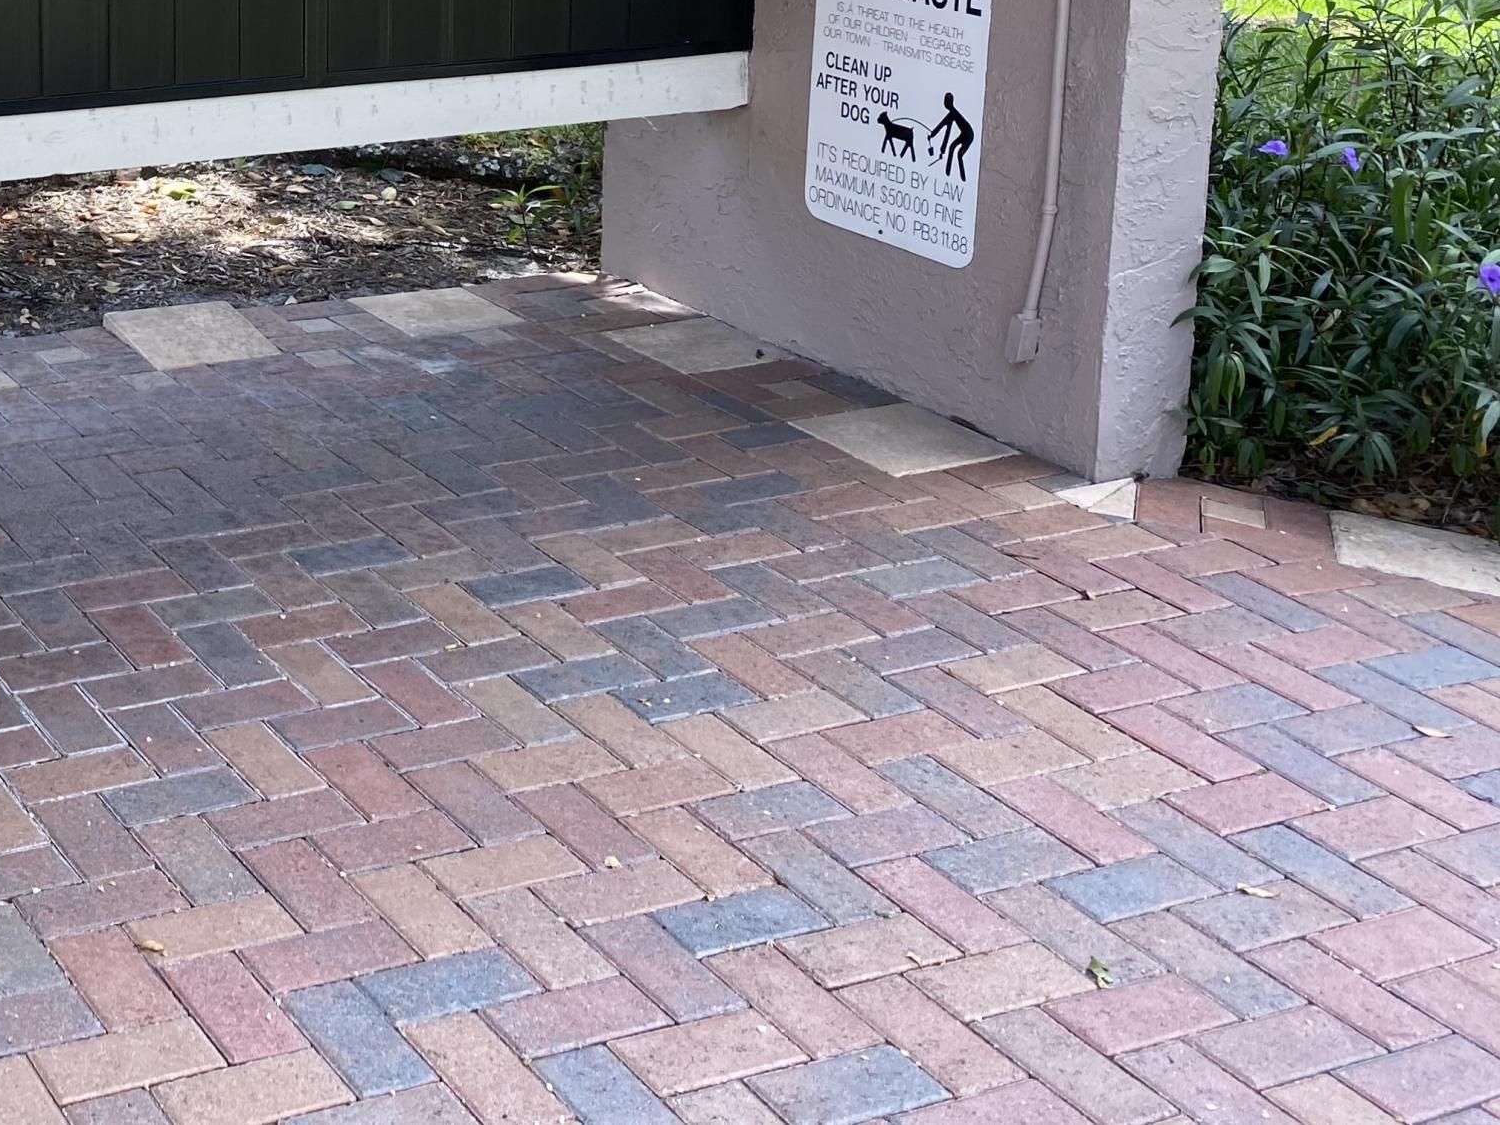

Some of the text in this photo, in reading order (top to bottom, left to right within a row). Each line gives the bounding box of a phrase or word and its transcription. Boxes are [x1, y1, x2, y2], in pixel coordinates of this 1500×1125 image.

[828, 13, 839, 25] OF
[843, 17, 861, 30] OUR
[864, 22, 908, 42] CHILDREN
[920, 35, 971, 57] DEGRADES
[836, 1, 964, 40] IS A THREAT TO THE HEALTH
[823, 26, 842, 39] OUR
[845, 31, 871, 47] TOWN
[883, 40, 932, 63] TRANSMITS
[935, 53, 975, 74] DISEASE
[826, 51, 892, 82] CLEAN UP
[816, 72, 899, 110] AFTER YOUR
[841, 102, 870, 124] DOG
[842, 149, 905, 185] REQUIRED
[911, 171, 929, 191] BY
[934, 178, 964, 203] LAW
[809, 185, 881, 225] ORDINANCE
[815, 165, 964, 228] MAXIMUM $500.00 FINE
